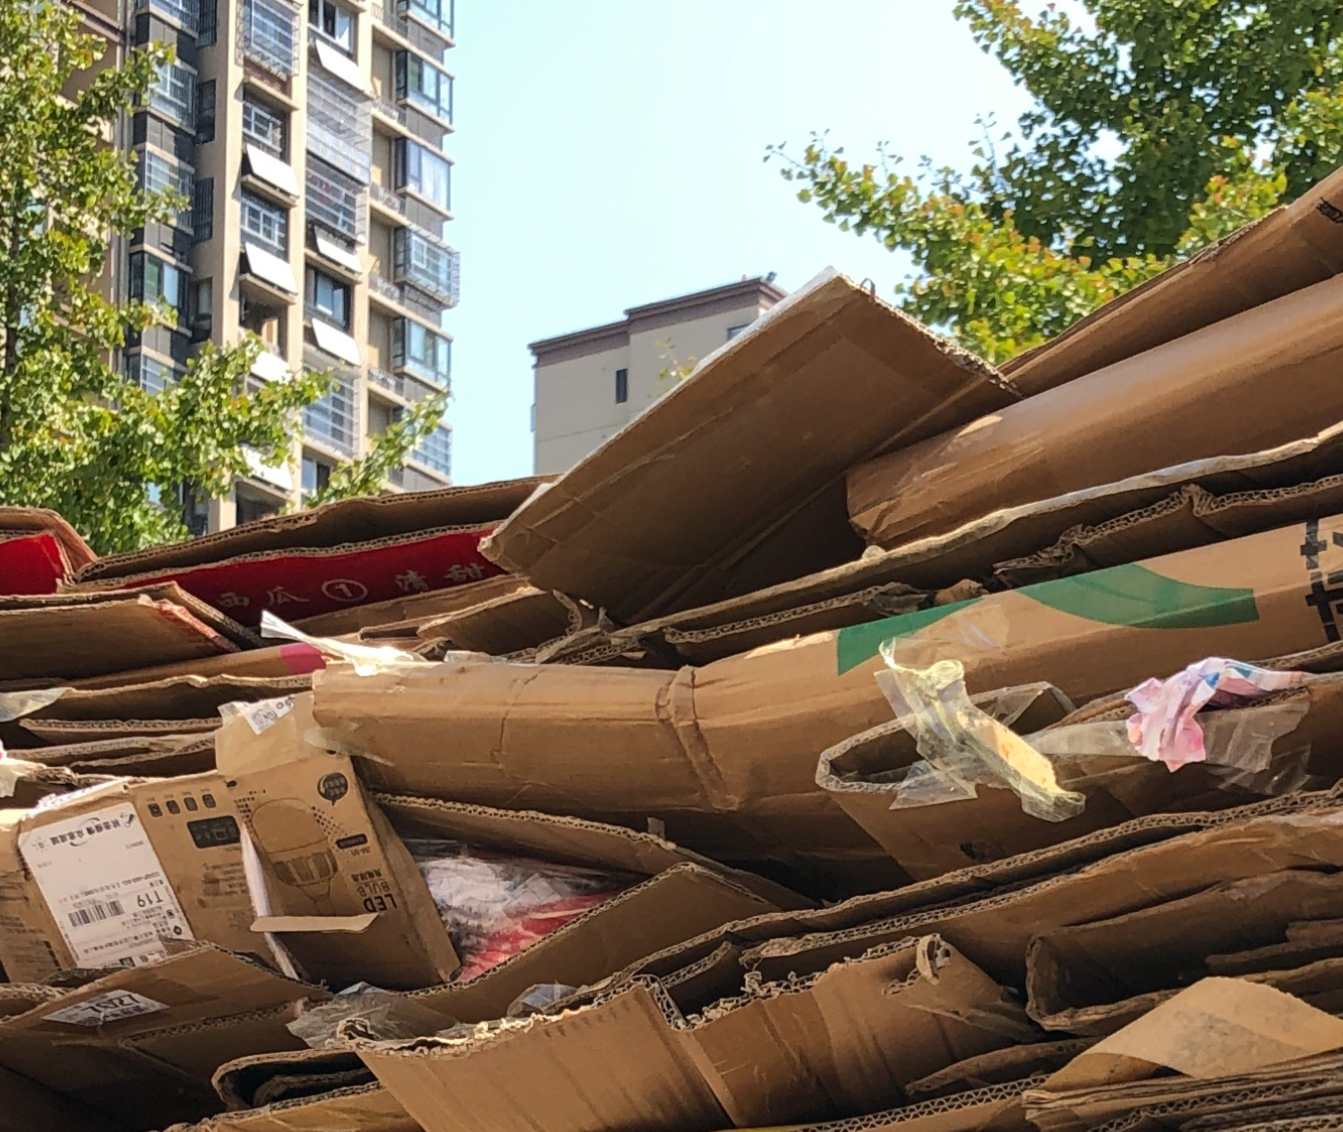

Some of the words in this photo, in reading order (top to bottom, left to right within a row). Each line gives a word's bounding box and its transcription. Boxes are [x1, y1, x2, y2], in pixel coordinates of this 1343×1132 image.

[216, 583, 311, 610] 西瓜
[136, 889, 164, 908] T19
[355, 880, 390, 897] BULB
[362, 892, 398, 914] LED
